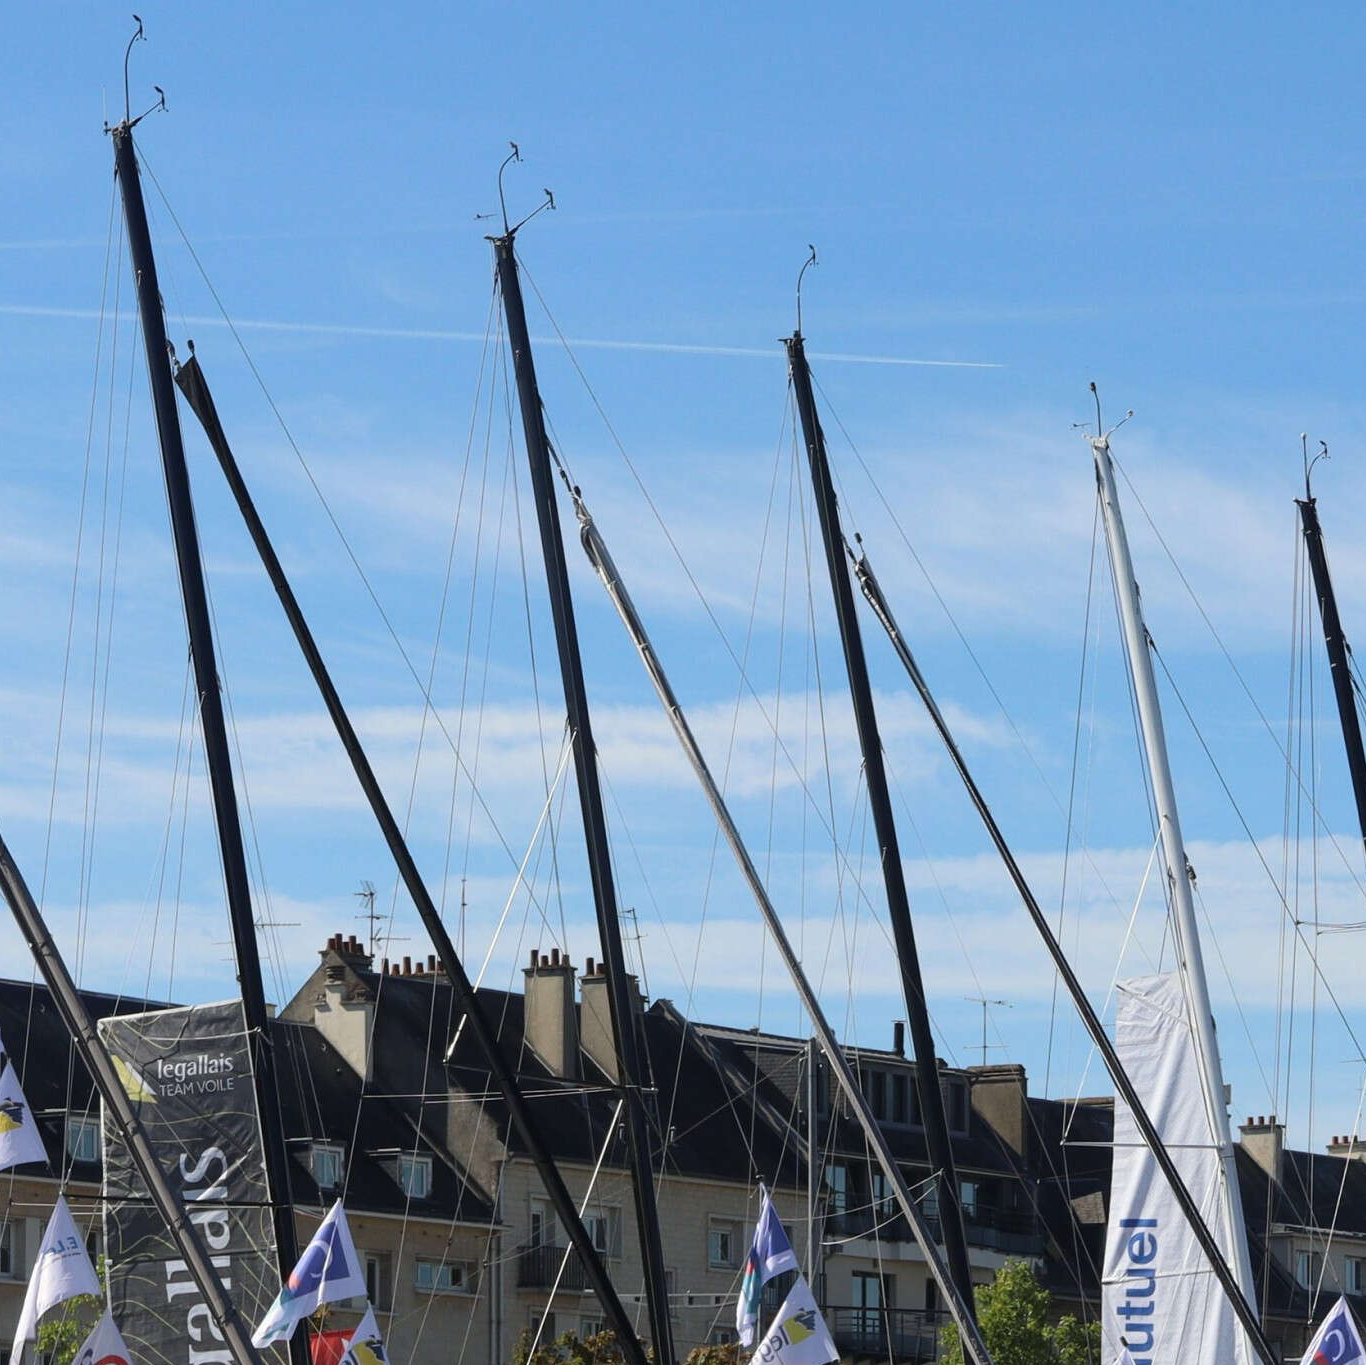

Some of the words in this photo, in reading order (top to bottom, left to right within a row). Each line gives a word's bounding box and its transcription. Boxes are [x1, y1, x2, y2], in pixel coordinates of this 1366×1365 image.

[157, 1053, 234, 1082] legallais
[160, 1082, 194, 1096] TEAM
[197, 1078, 234, 1094] VOILE
